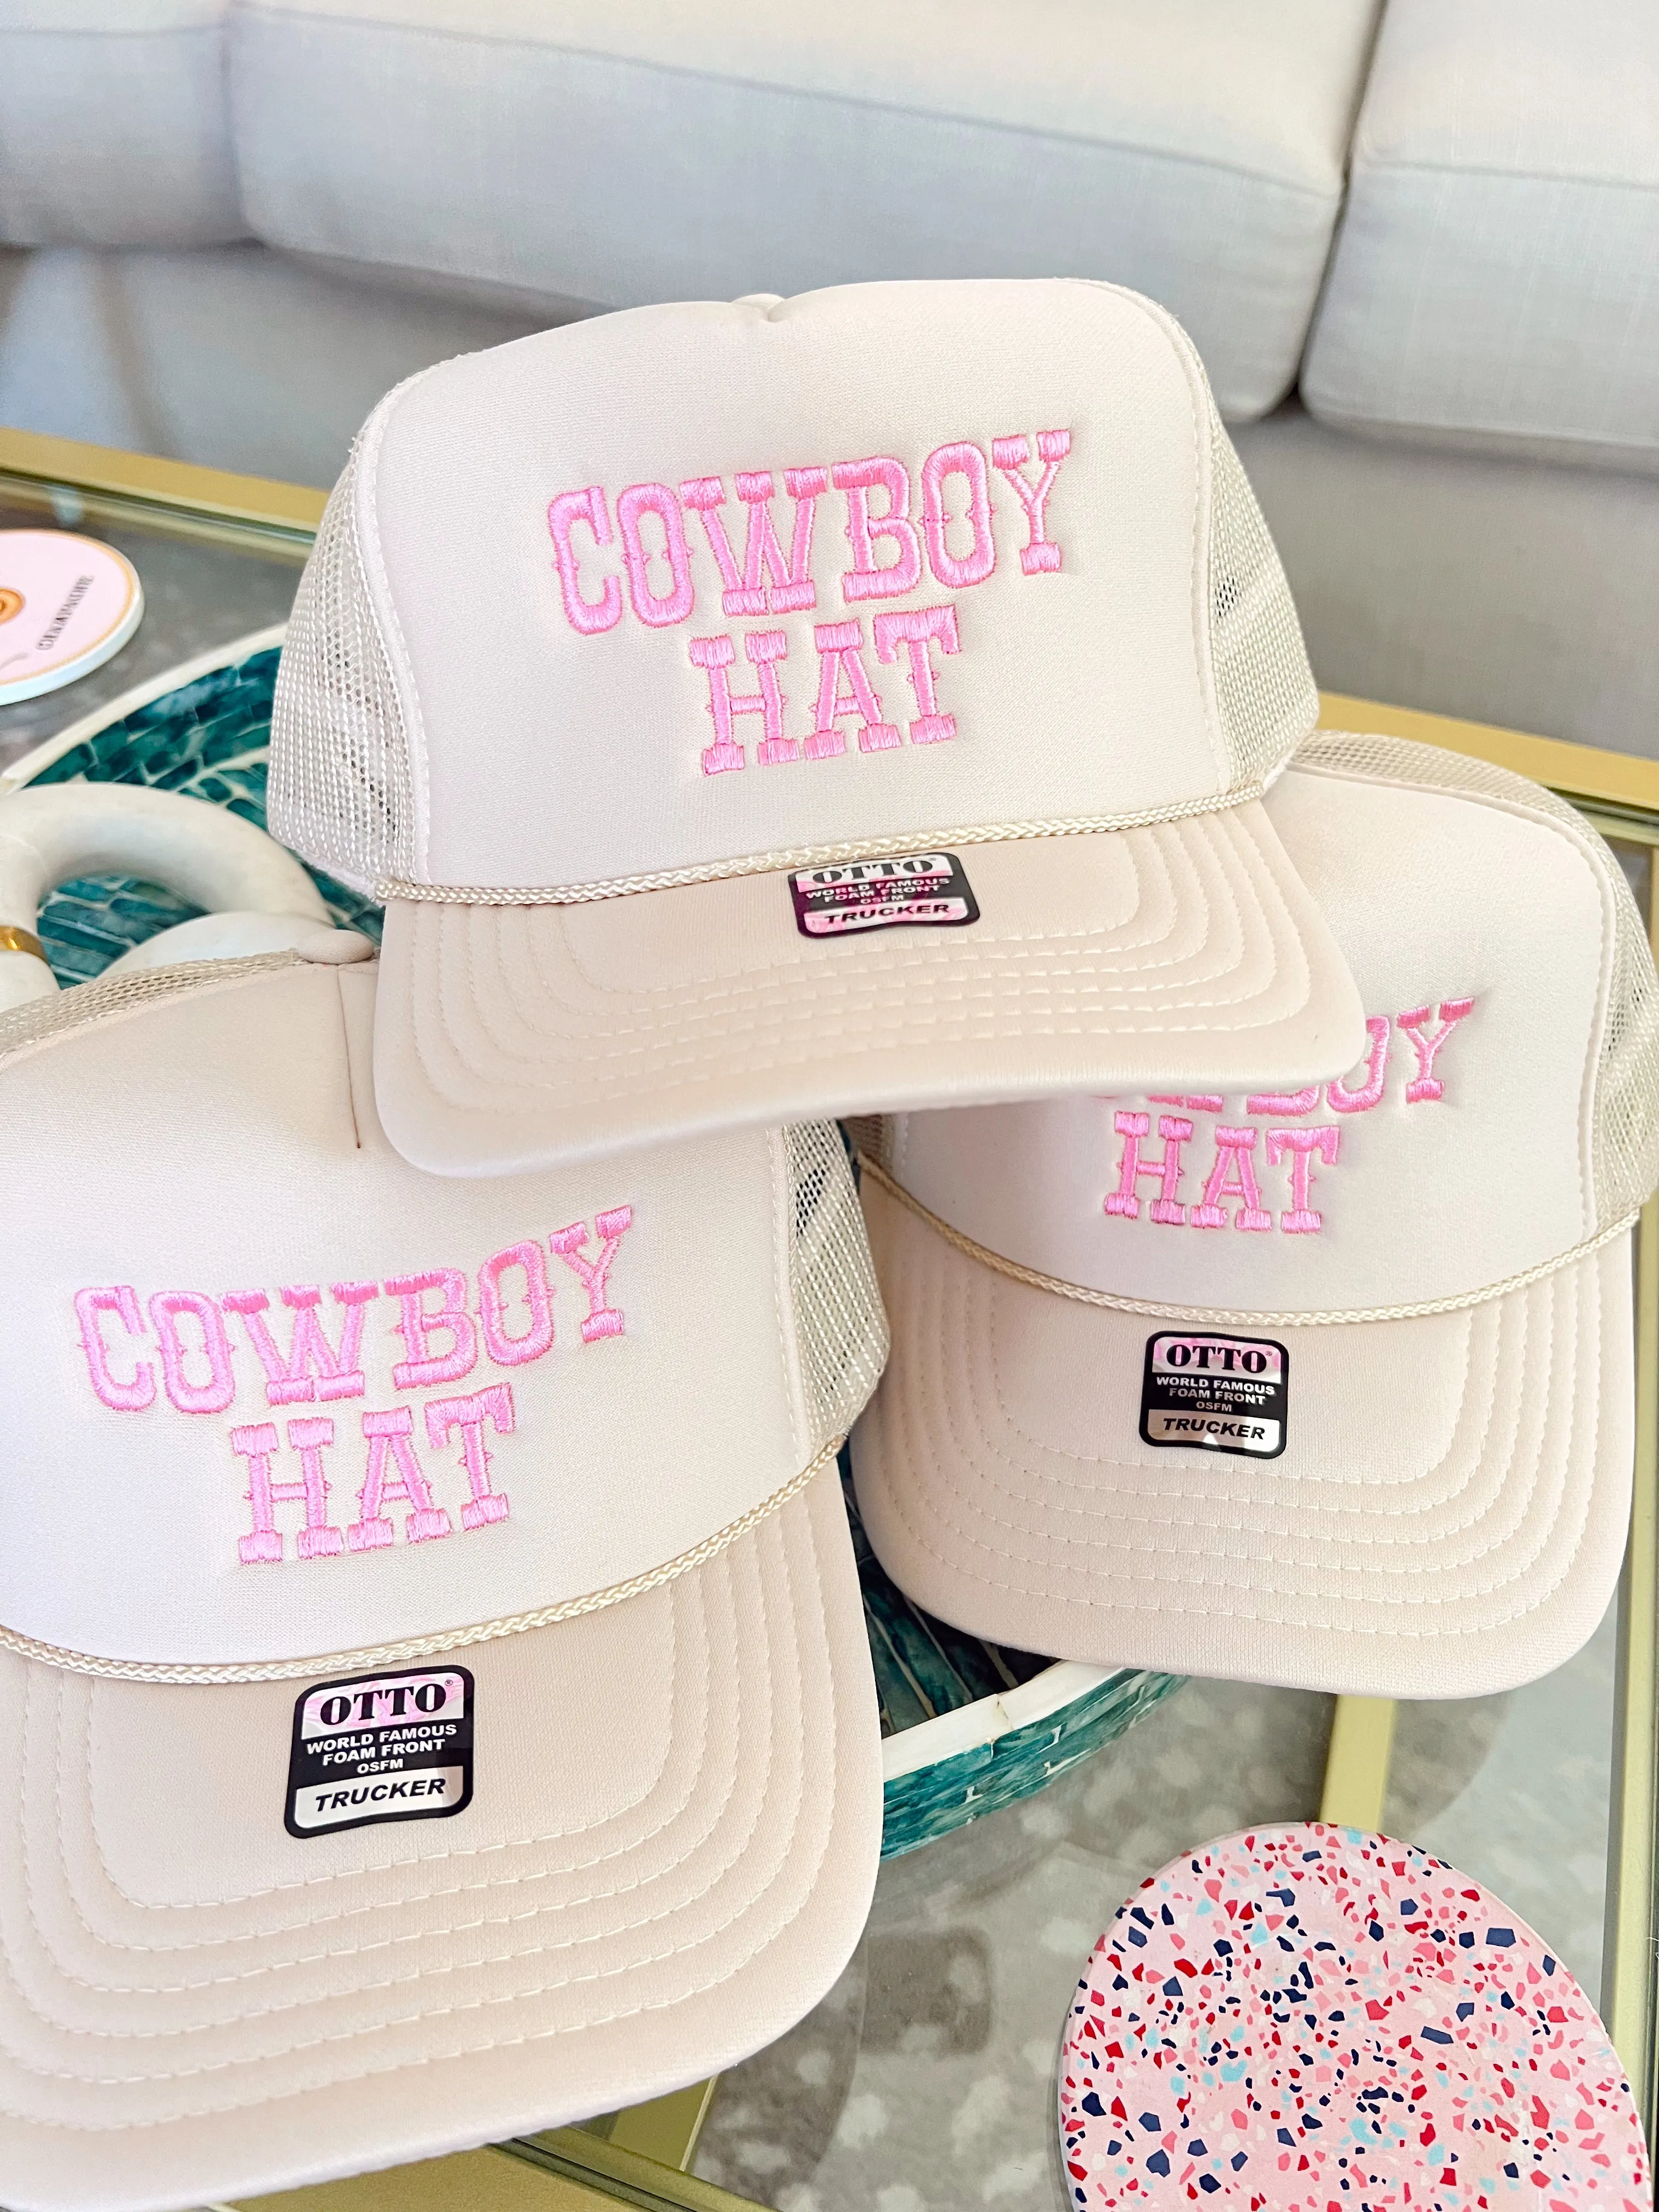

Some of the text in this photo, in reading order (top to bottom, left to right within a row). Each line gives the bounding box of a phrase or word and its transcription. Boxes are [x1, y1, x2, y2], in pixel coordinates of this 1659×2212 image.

[548, 429, 1071, 634] COWBOY
[689, 603, 962, 775] HAT
[806, 878, 950, 899] WORLD FAMOUS
[825, 885, 941, 903] FOAM FRONT
[860, 894, 904, 905] OSFM
[824, 904, 949, 924] TRUCKER
[1104, 1110, 1341, 1234] HAT
[73, 1204, 632, 1414] COWBOY
[1156, 1376, 1276, 1396] WORLD FAMOUS
[1169, 1387, 1266, 1405] FOAM FRONT
[1196, 1401, 1232, 1412] OSFM
[1163, 1418, 1266, 1440] TRUCKER
[230, 1382, 516, 1565] HAT
[307, 1724, 457, 1755] WORLD FAMOUS
[323, 1739, 445, 1766] FOAM FRONT
[357, 1758, 403, 1774] OSFM
[315, 1778, 446, 1812] TRUCKER
